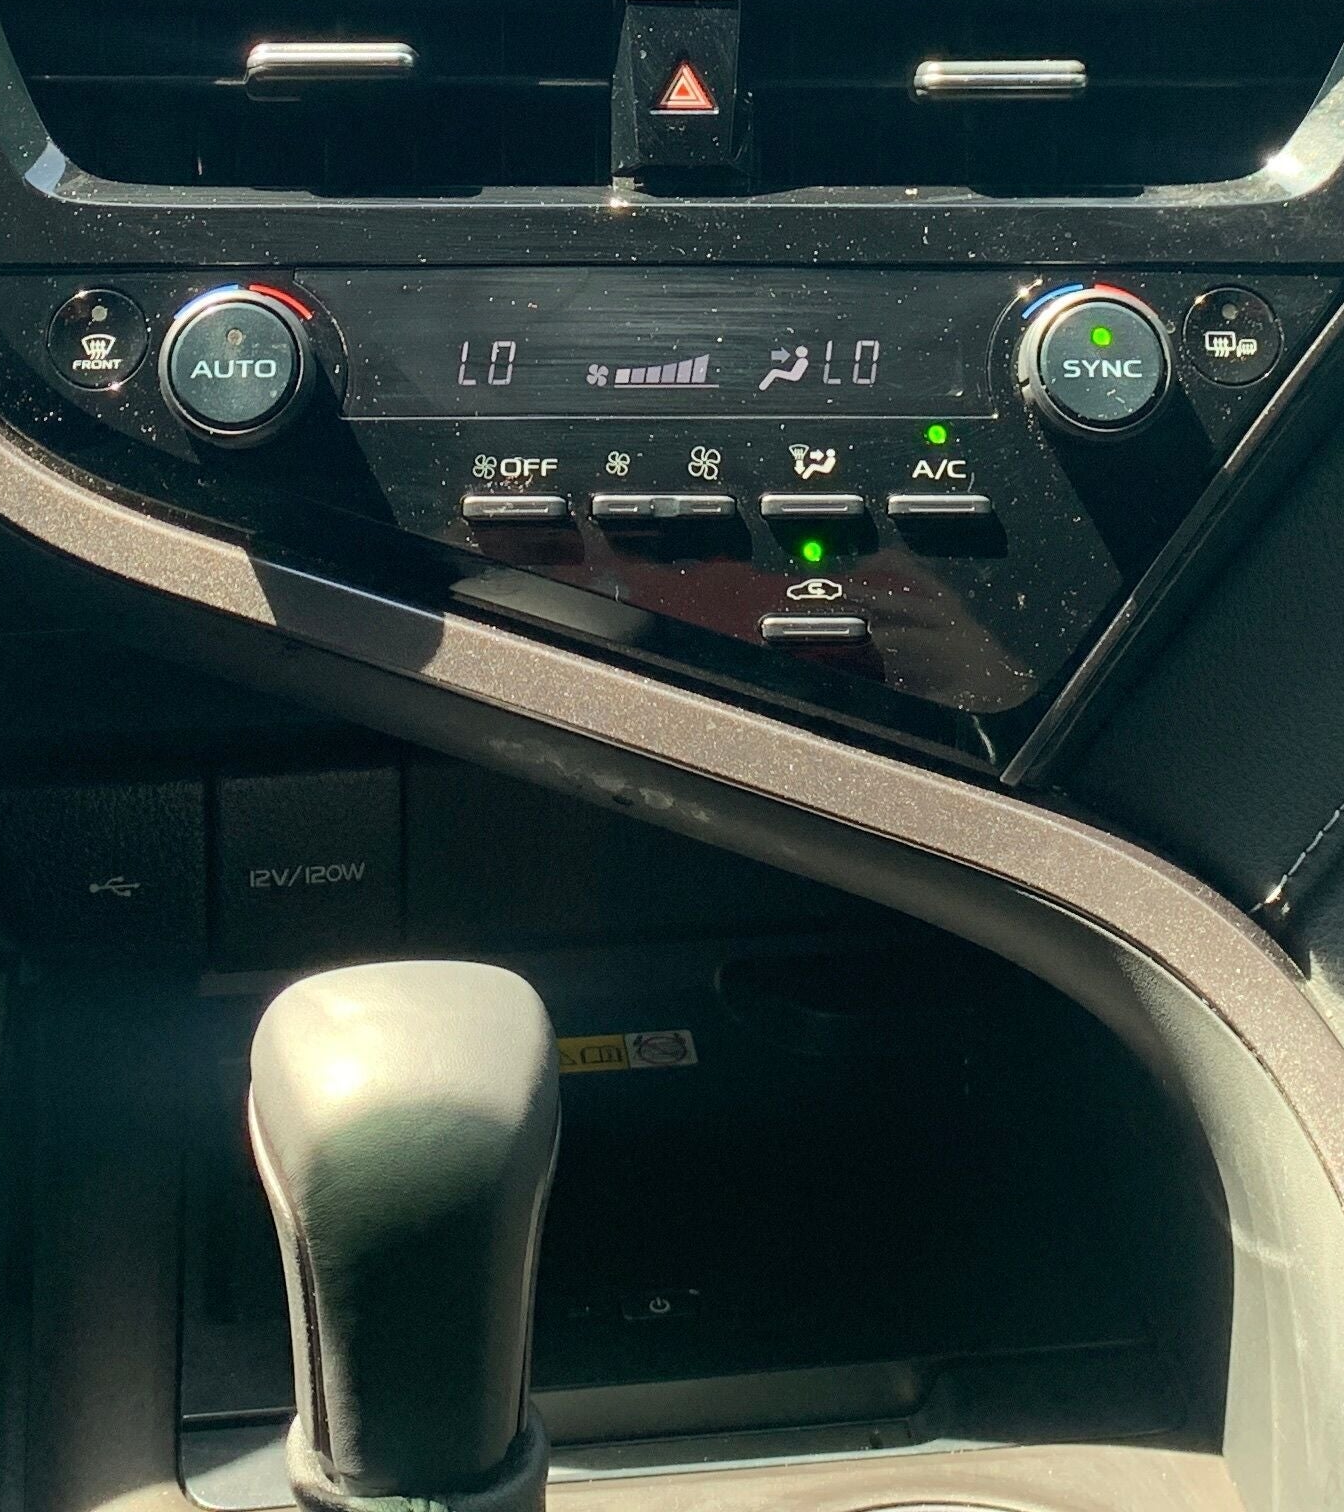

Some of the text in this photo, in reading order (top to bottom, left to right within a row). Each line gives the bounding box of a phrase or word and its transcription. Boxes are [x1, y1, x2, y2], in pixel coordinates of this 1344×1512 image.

[72, 358, 123, 371] FRONT
[190, 359, 278, 380] AUTO
[1063, 359, 1144, 378] SYNC
[500, 458, 559, 478] OFF
[912, 459, 967, 480] A/C
[249, 862, 366, 887] 12V/120W
